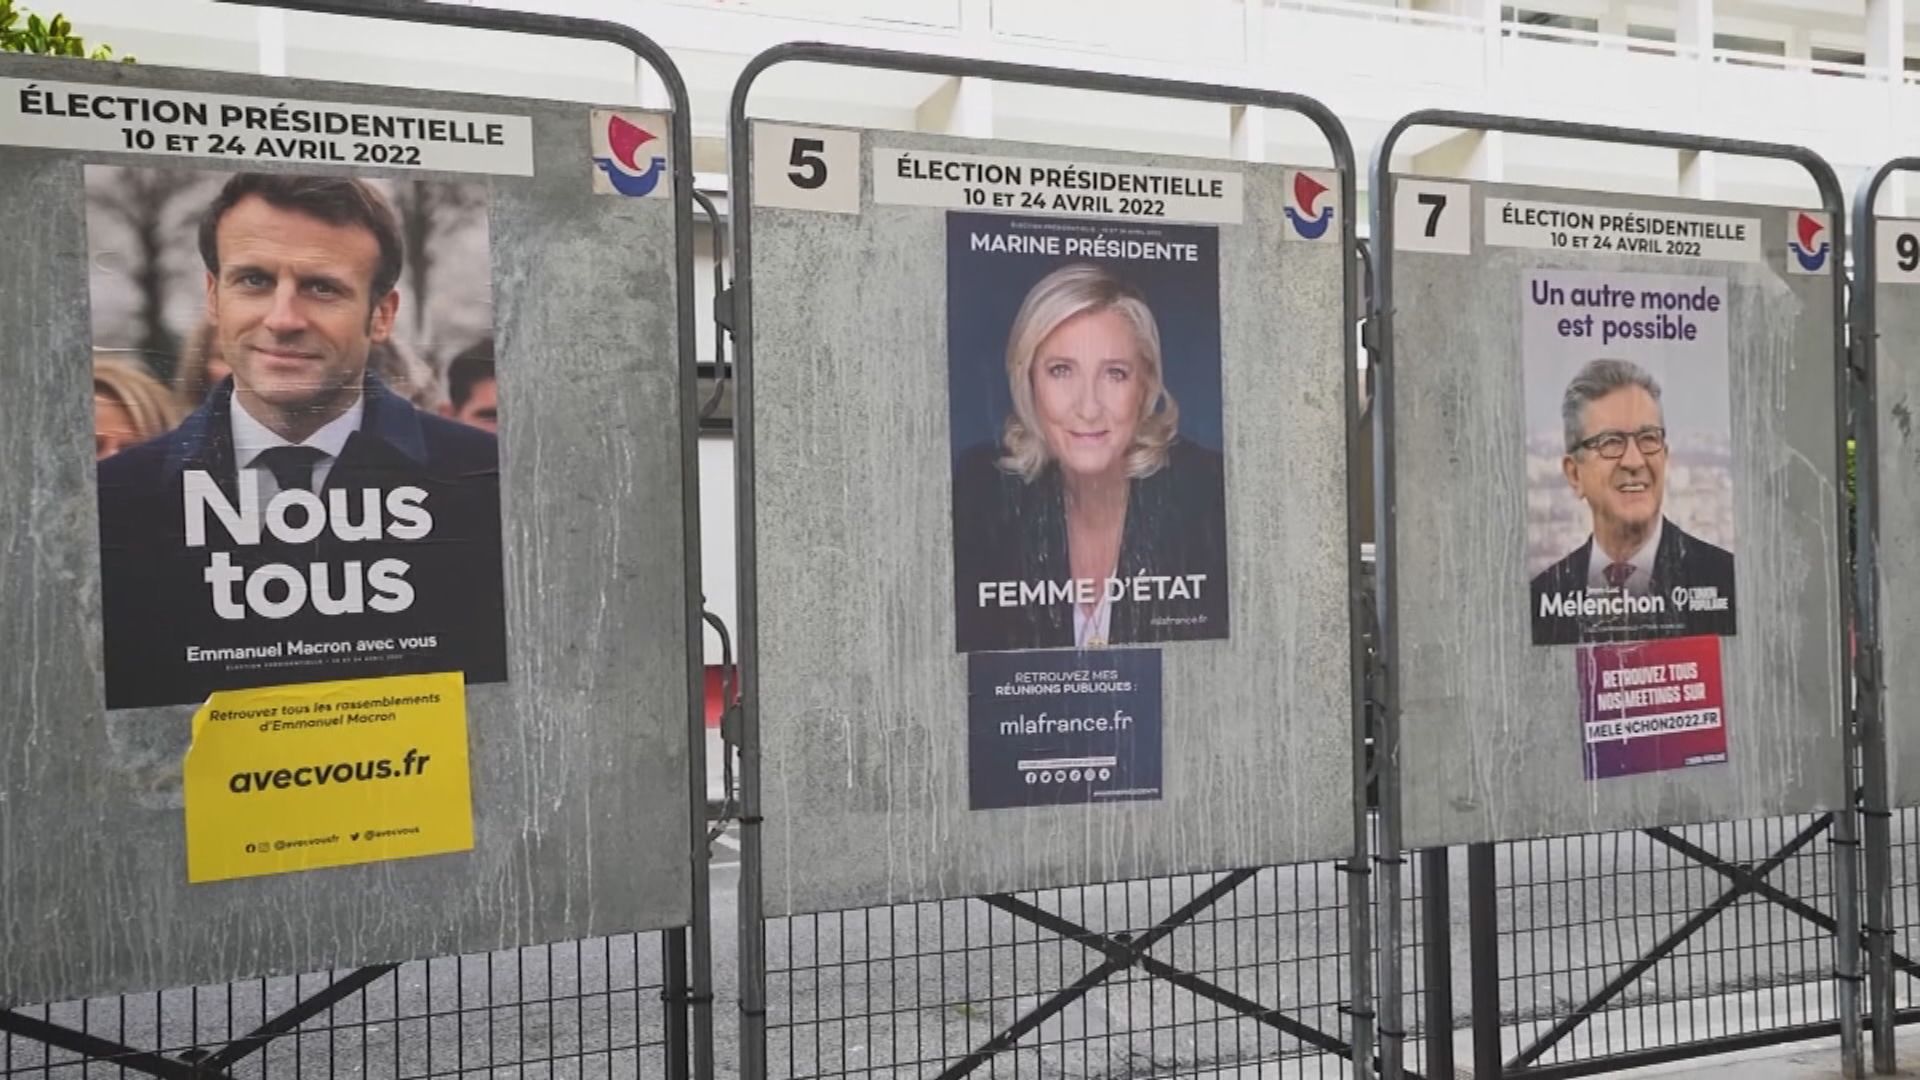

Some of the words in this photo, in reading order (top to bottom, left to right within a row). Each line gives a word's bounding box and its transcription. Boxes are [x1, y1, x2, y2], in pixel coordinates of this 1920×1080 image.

[20, 84, 208, 126] ÉLECTION
[221, 102, 504, 145] PRÉSIDENTIELLE
[122, 128, 155, 150] 10
[166, 134, 199, 152] ET
[208, 134, 246, 155] 24
[255, 137, 345, 161] AVRIL
[353, 143, 421, 165] 2022
[787, 138, 828, 189] 5
[897, 152, 1021, 186] ÉLECTION
[1030, 165, 1223, 198] PRÉSIDENTIELLE
[963, 188, 985, 206] 10
[993, 193, 1015, 207] ET
[1021, 192, 1046, 209] 24
[1052, 194, 1113, 213] AVRIL
[1119, 198, 1165, 216] 2022
[1418, 193, 1447, 237] 7
[1502, 202, 1594, 230] ÉLECTION
[1600, 212, 1746, 241] PRÉSIDENTIELLE
[970, 232, 1060, 255] MARINE
[1065, 234, 1199, 262] PRÉSIDENTE
[1551, 232, 1567, 248] 10
[1572, 236, 1588, 248] ET
[1593, 235, 1612, 250] 24
[1616, 237, 1662, 253] AVRIL
[1666, 240, 1701, 257] 2022
[1896, 233, 1919, 272] 9
[1531, 279, 1565, 306] Un
[1571, 284, 1635, 309] autre
[1641, 285, 1721, 312] monde
[1557, 314, 1594, 338] est
[1602, 314, 1698, 345] possible
[183, 468, 433, 547] Nous
[204, 552, 415, 619] tous
[978, 577, 1096, 608] FEMME
[1103, 568, 1207, 602] D'ÉTAT
[1539, 588, 1665, 618] Mélenchon
[186, 642, 282, 662] Emmanuel
[287, 640, 352, 655] Macron
[356, 639, 394, 652] avec
[398, 635, 437, 650] vous
[1014, 670, 1089, 683] RETROUVEZ
[1092, 669, 1118, 682] MES
[1668, 662, 1698, 682] TOUS
[995, 682, 1061, 696] RÉUNIONS
[1063, 680, 1132, 695] PUBLIQUES
[1683, 682, 1707, 701] SUR
[210, 708, 277, 722] Retrouvez
[282, 705, 310, 717] tous
[313, 702, 332, 713] les
[335, 693, 441, 712] rassemblements
[259, 716, 344, 733] d'Emmanuel
[347, 711, 396, 725] Macron
[1000, 710, 1133, 736] mlafrance.fr
[229, 749, 430, 793] avecvous.fr
